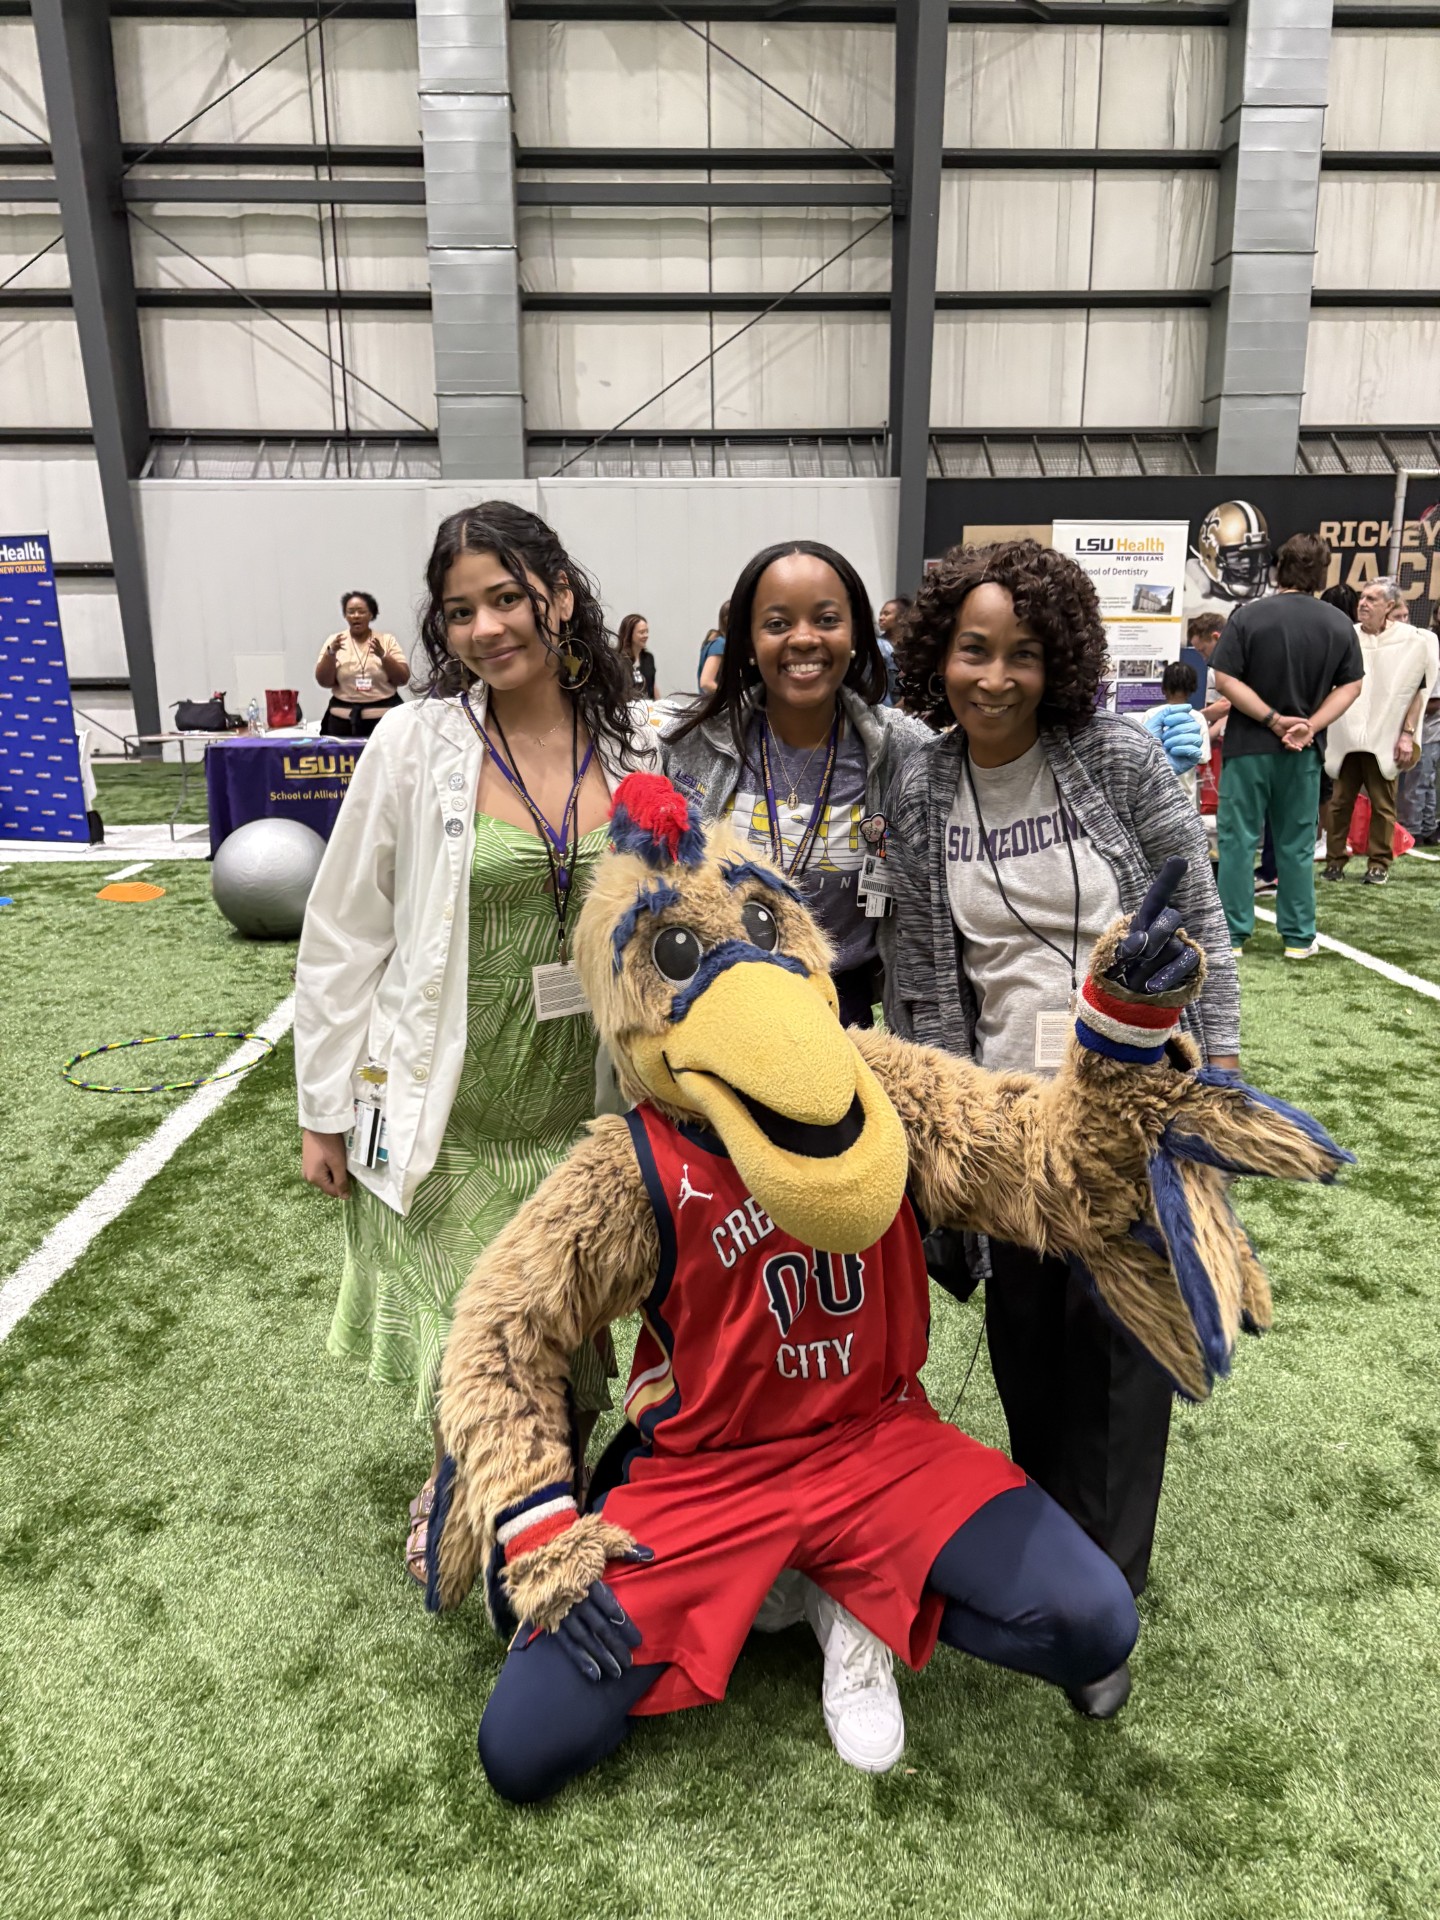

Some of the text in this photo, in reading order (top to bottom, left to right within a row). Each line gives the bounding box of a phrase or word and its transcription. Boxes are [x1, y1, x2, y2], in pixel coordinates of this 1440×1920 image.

[1320, 521, 1440, 547] RICKEY
[1075, 537, 1165, 552] LSU Health
[15, 565, 47, 574] ORLEANS
[1102, 567, 1111, 576] of
[1112, 567, 1149, 578] Dentistry
[283, 755, 336, 774] LSU
[270, 791, 300, 801] School
[303, 790, 312, 800] of
[314, 789, 338, 799] Allied
[948, 804, 1080, 862] SU MEDICIN
[776, 1332, 854, 1379] CITY
